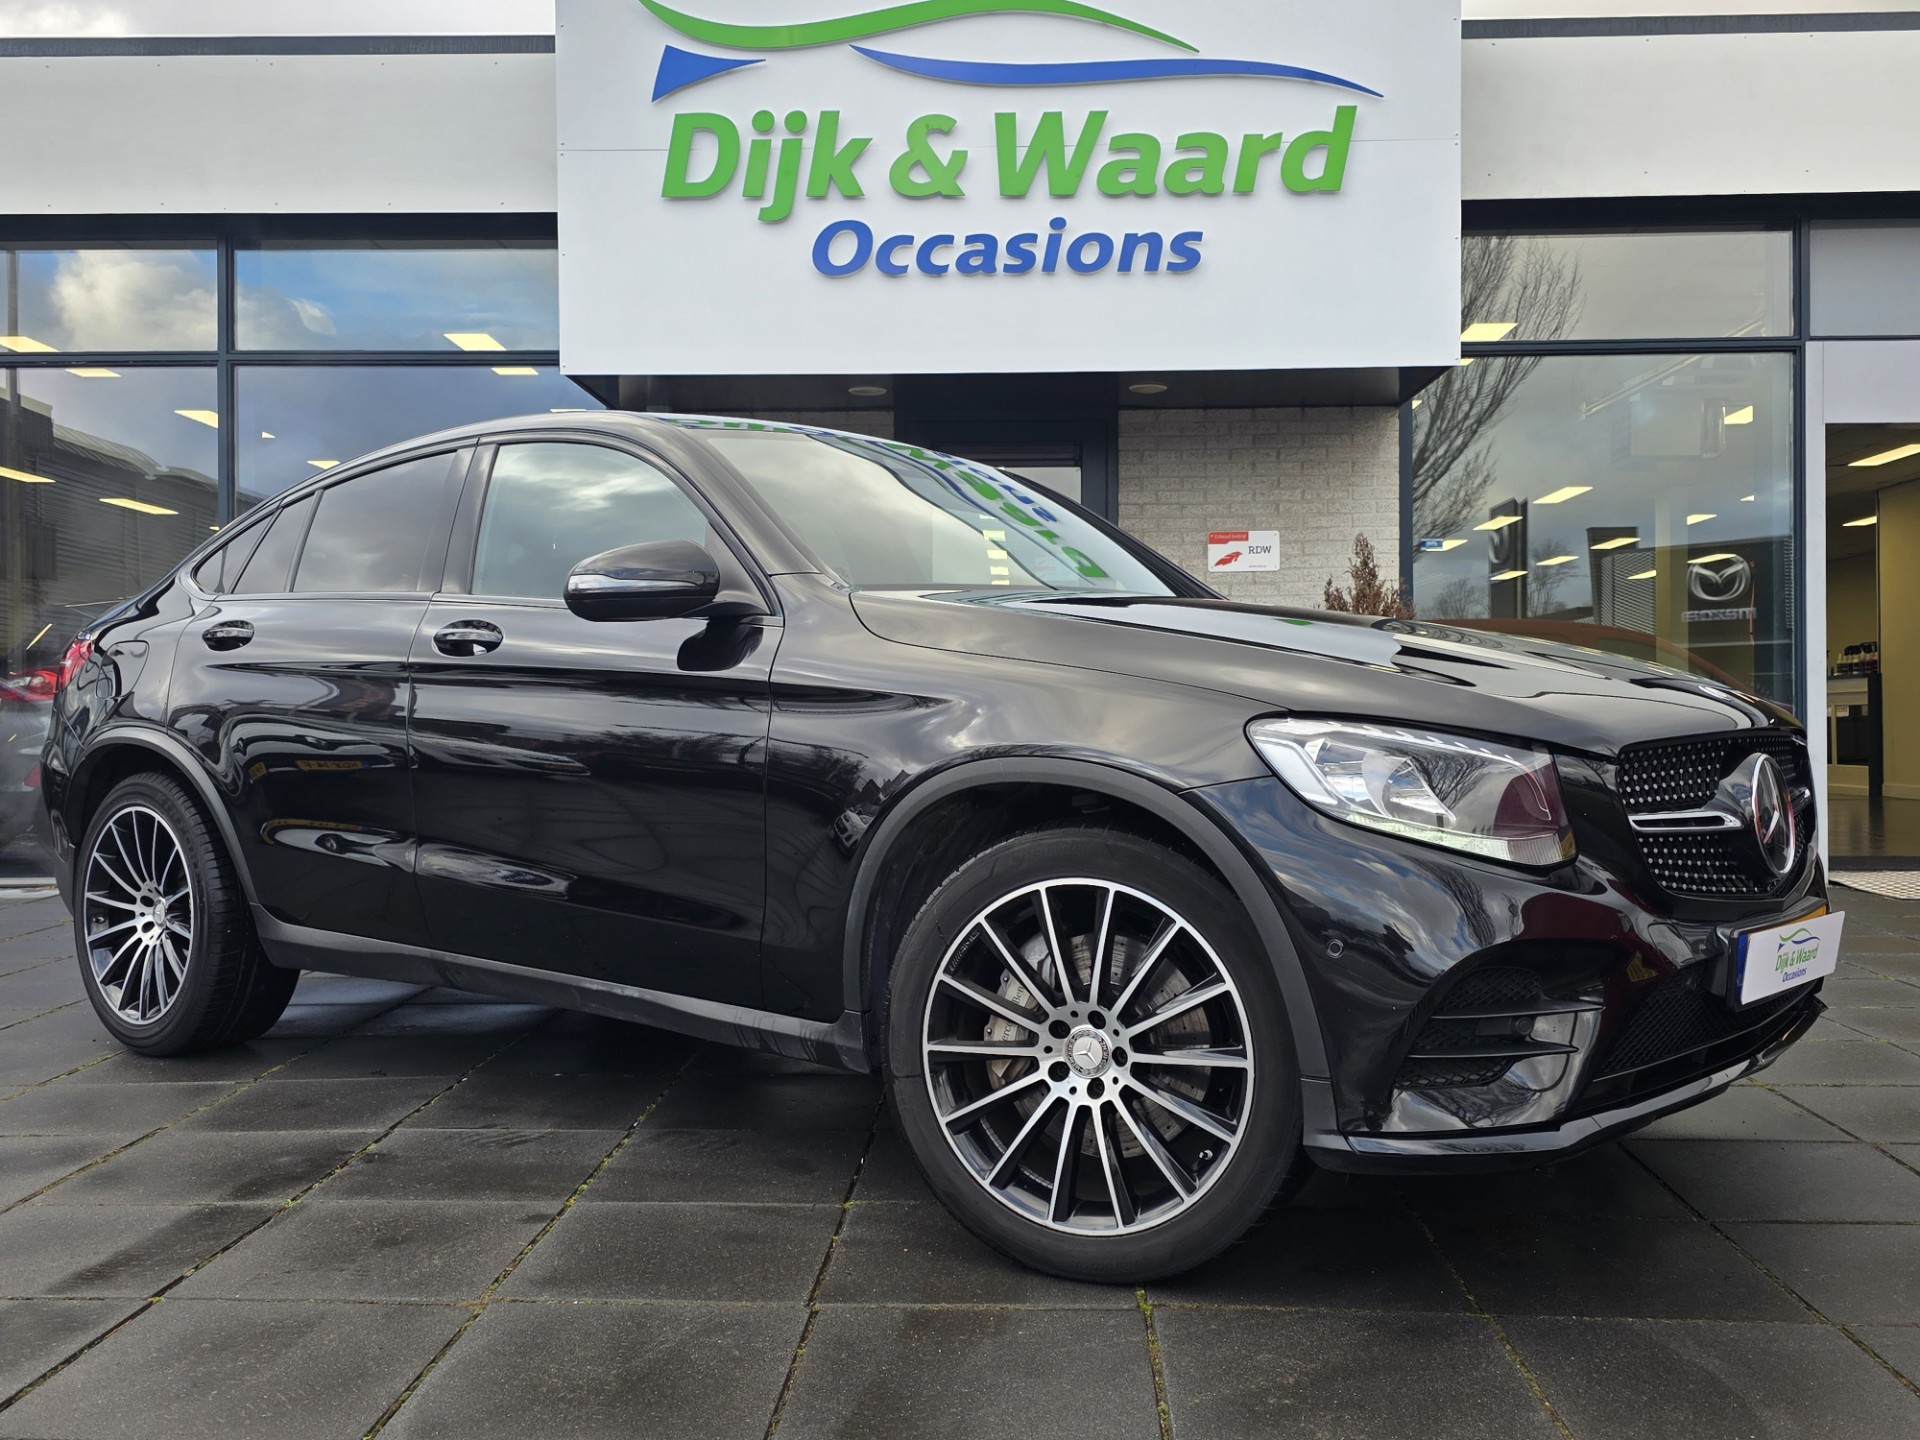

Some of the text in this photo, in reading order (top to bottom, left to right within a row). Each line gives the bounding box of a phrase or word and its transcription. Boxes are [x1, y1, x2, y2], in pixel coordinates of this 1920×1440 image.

[661, 106, 1357, 222] Dijk & Waard
[812, 218, 1203, 277] Occasions
[1248, 545, 1272, 555] RDW
[1775, 952, 1789, 973] Dijk
[1796, 943, 1819, 964] Waard
[1782, 968, 1807, 982] Occasions
